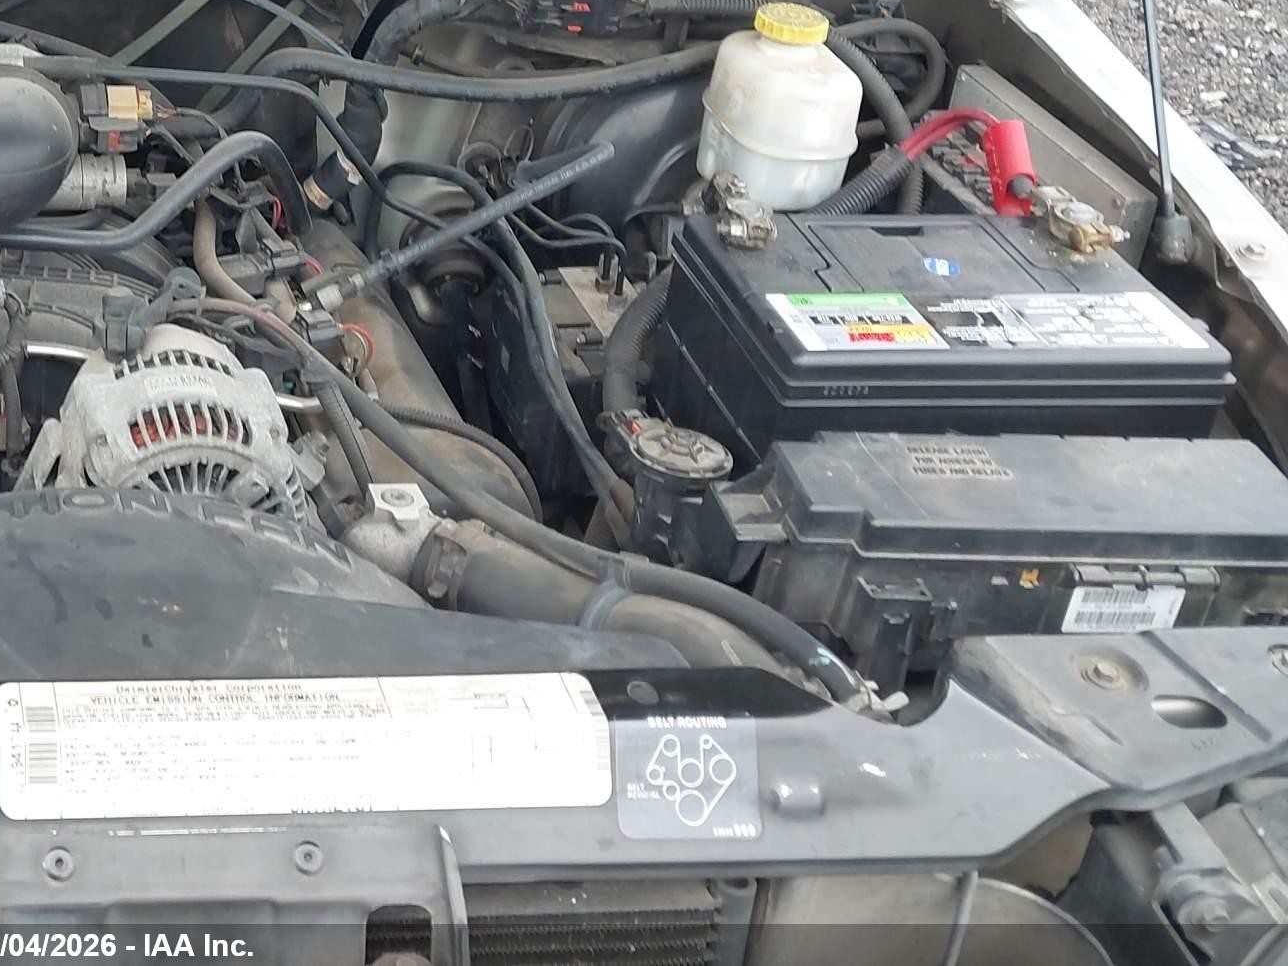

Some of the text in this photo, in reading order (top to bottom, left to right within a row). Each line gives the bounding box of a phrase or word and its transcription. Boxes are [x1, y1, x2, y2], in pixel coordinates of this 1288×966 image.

[906, 445, 987, 456] RELEASE LATCH
[914, 456, 993, 466] FOR ACCESS TO
[115, 683, 303, 697] DaimlerChrysler Corporation
[91, 692, 339, 706] VEHICLE EMISSION CONTROL INFORMATION
[647, 716, 727, 729] BELT ROUTING
